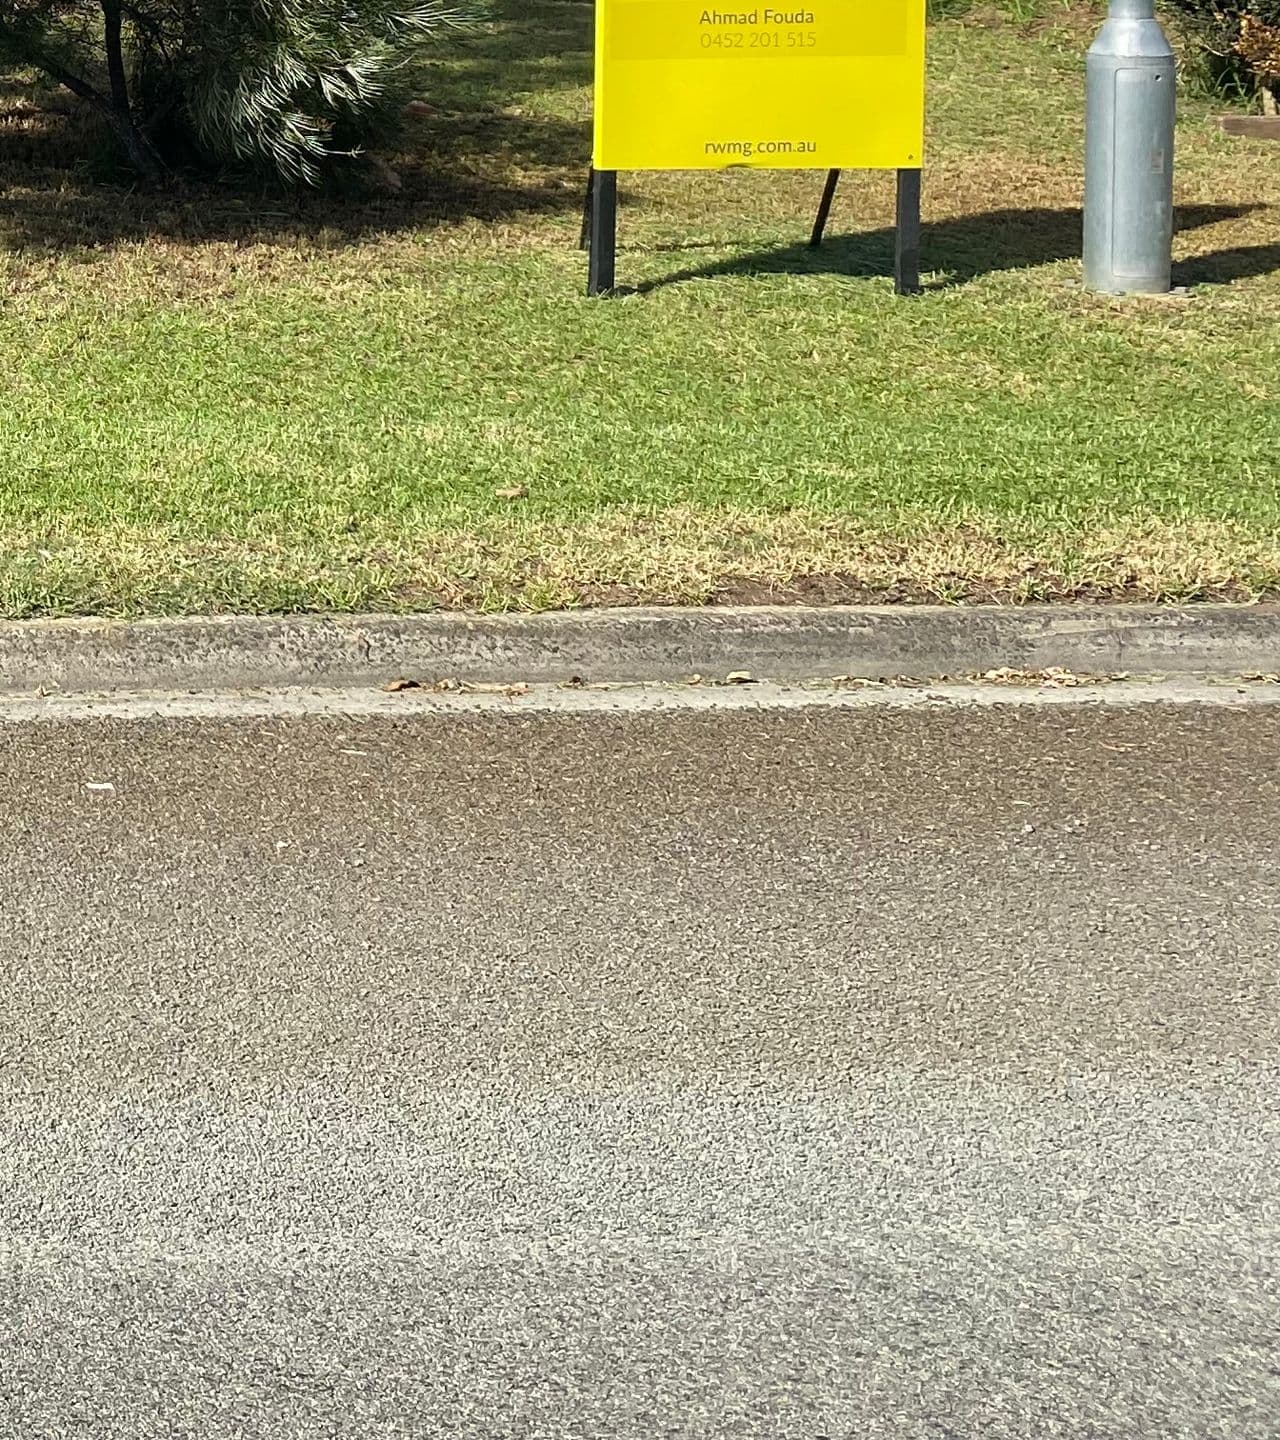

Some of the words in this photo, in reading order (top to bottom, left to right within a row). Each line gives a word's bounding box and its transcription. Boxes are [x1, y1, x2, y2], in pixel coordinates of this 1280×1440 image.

[699, 10, 758, 25] Ahmad
[764, 9, 814, 24] Fouda
[700, 33, 744, 48] 0452
[750, 32, 780, 48] 201
[787, 31, 816, 47] 515
[704, 139, 817, 156] rwmg.com.au
